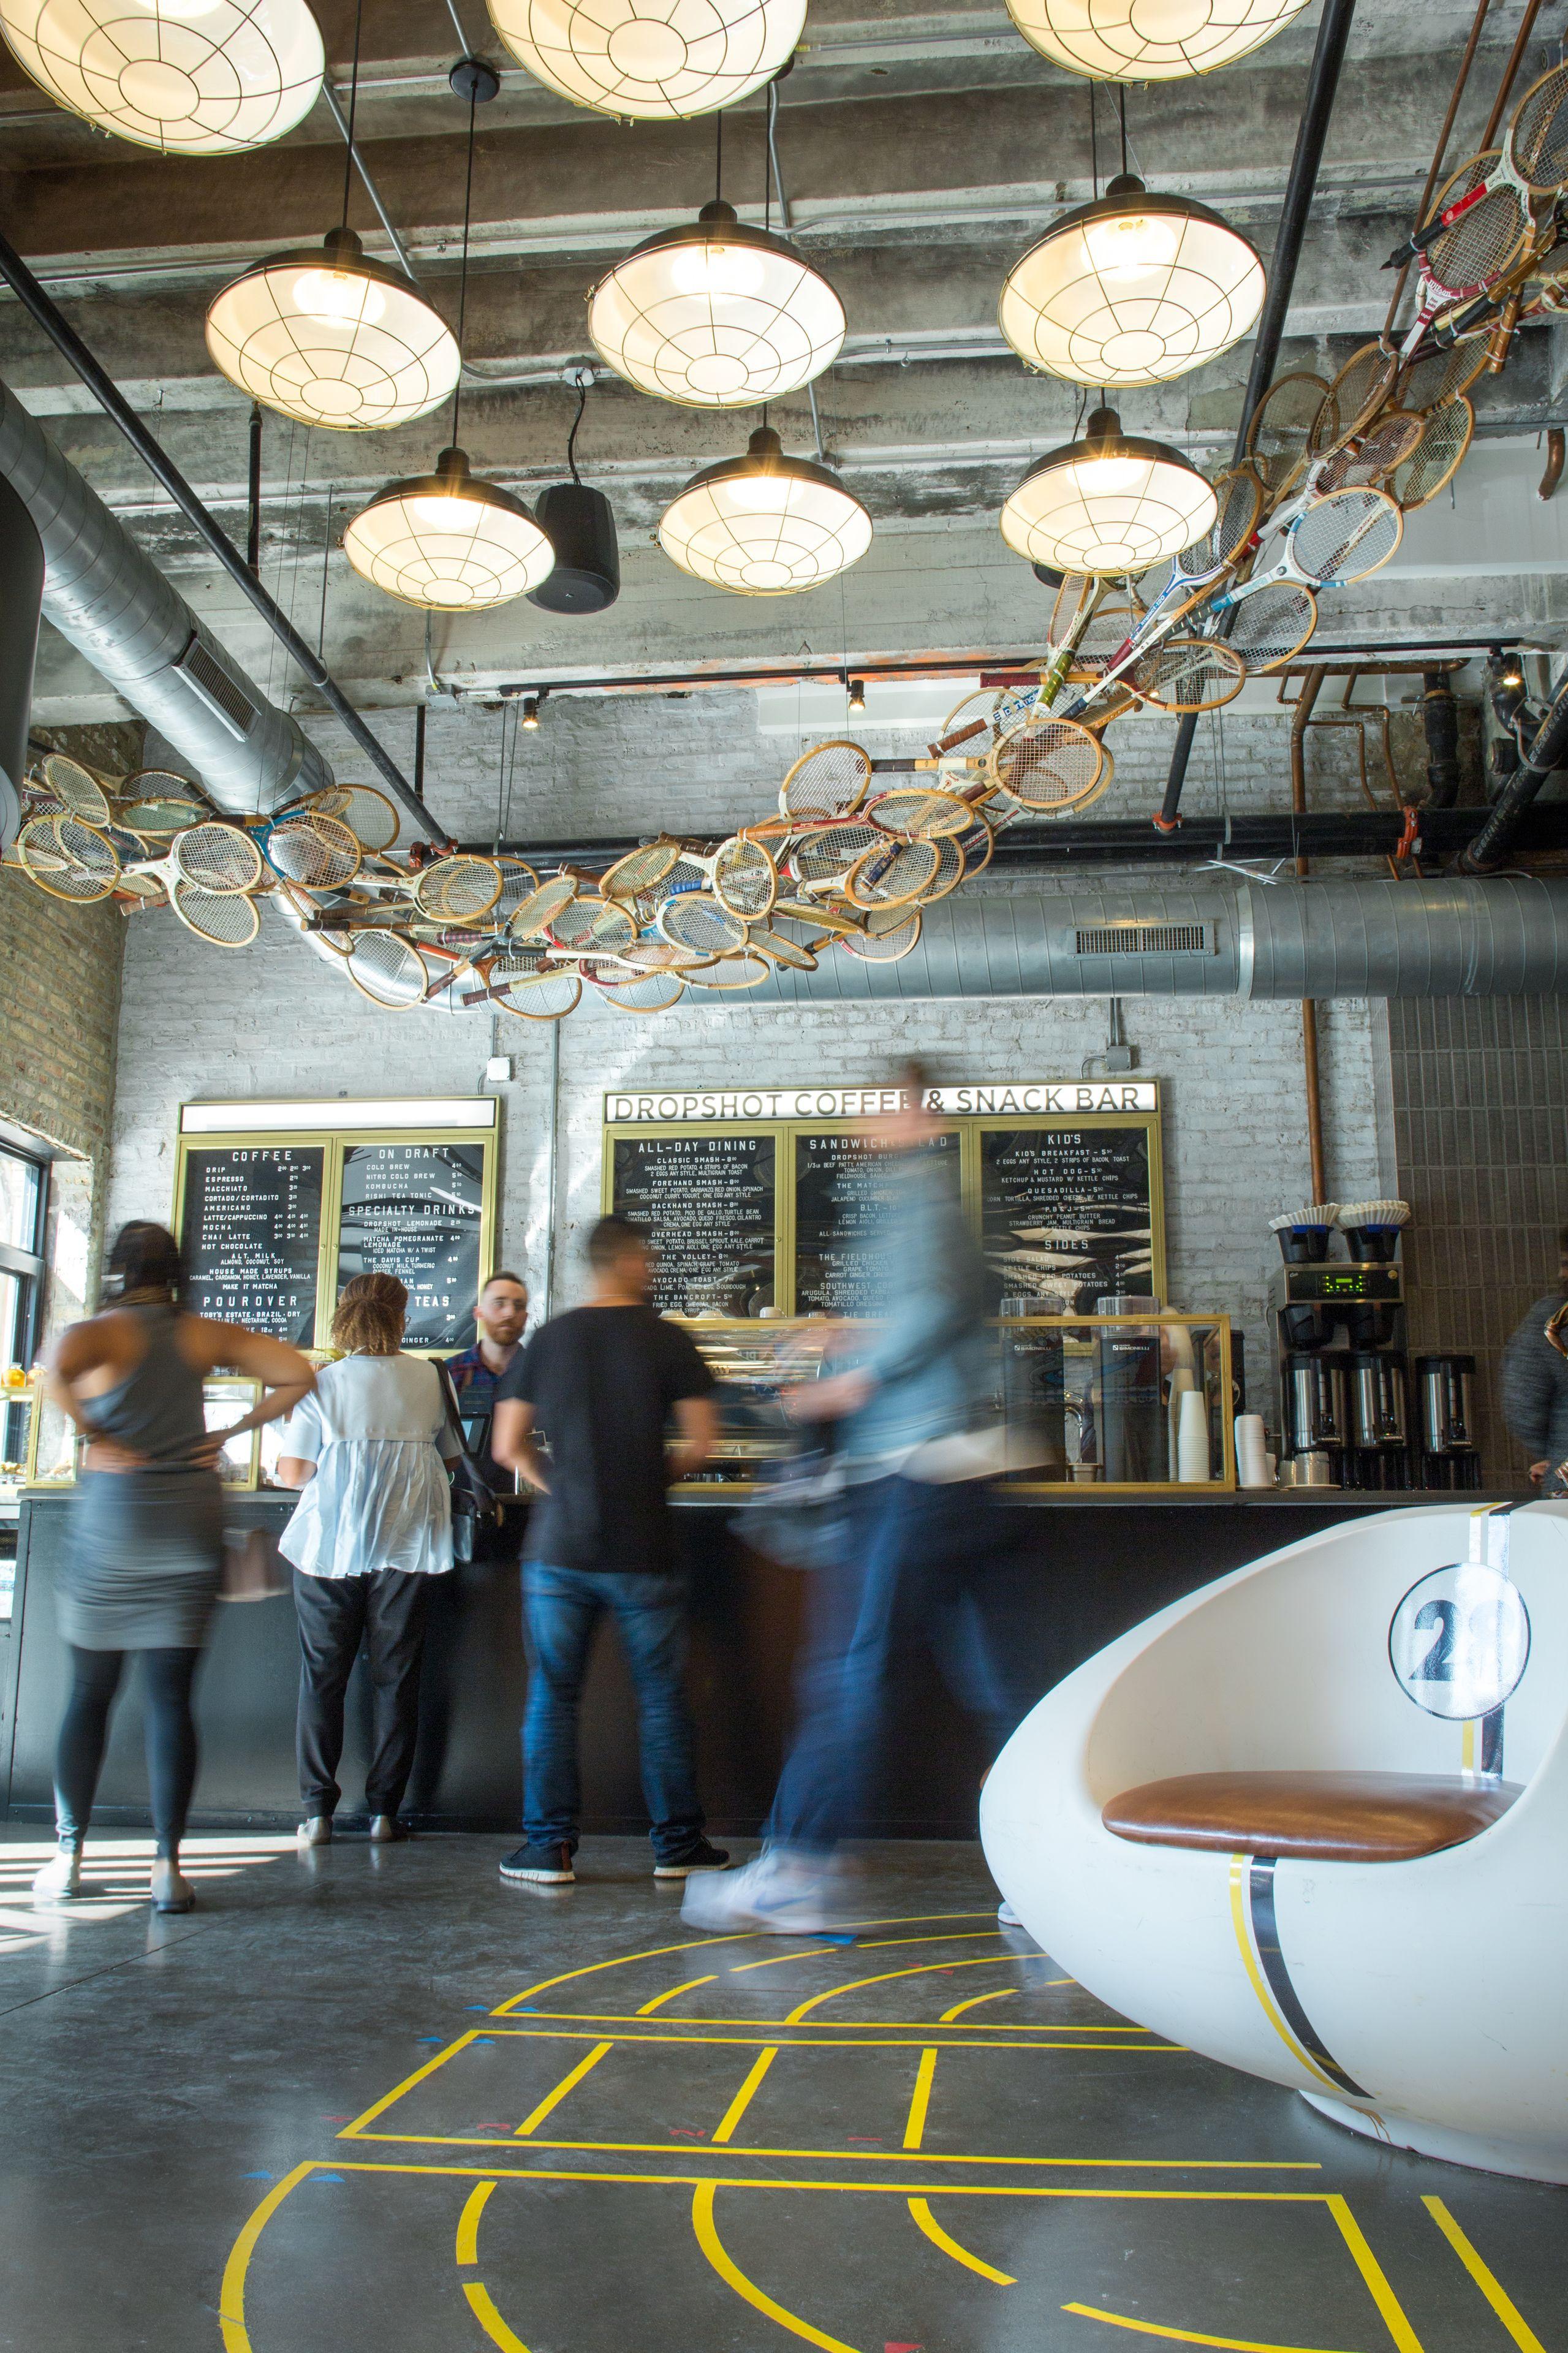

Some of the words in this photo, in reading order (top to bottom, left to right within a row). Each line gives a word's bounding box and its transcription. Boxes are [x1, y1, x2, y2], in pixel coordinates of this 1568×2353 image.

[1428, 279, 1452, 298] Wilson
[615, 1093, 780, 1120] DROPSHOT
[795, 1091, 914, 1116] COFFEE
[926, 1089, 945, 1113] &
[956, 1088, 1064, 1113] SNACK
[1075, 1087, 1140, 1111] BAR
[638, 1142, 698, 1153] ALL-DAY
[709, 1141, 756, 1151] DINING
[232, 1151, 291, 1161] COFFEE
[379, 1149, 394, 1159] ON
[406, 1148, 449, 1158] DRAFT
[349, 1205, 415, 1216] SPECIALTY
[424, 1205, 474, 1214] DRINKS
[1045, 1240, 1088, 1250] SIDES
[203, 1296, 297, 1307] POUROVER
[415, 1296, 449, 1306] TEAS
